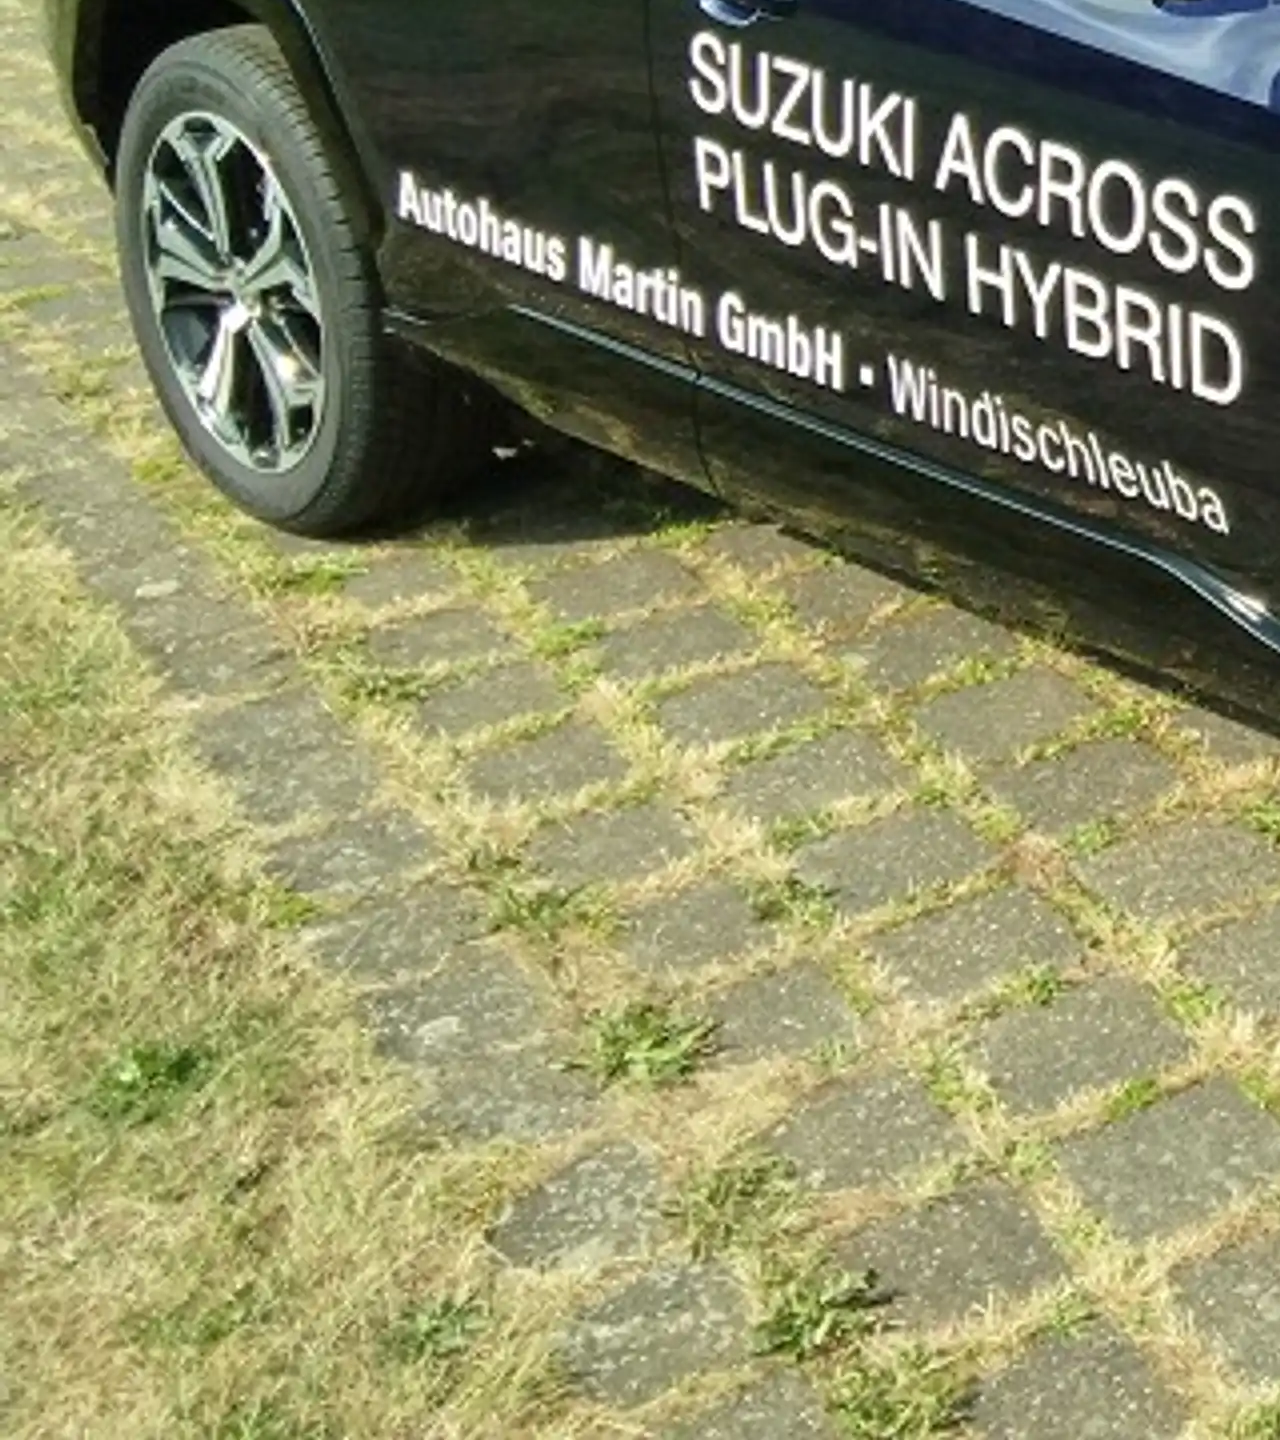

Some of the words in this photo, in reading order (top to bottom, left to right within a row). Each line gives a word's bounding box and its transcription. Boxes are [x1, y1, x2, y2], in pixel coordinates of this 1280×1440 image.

[689, 30, 915, 181] SUZUKI
[934, 111, 1256, 291] ACROSS
[695, 136, 946, 302] PLUG-IN
[965, 231, 1243, 406] HYBRID
[398, 170, 566, 283] Autohaus
[577, 236, 705, 338] Martin
[718, 291, 845, 392] GmbH
[887, 353, 1230, 535] Windischleuba
